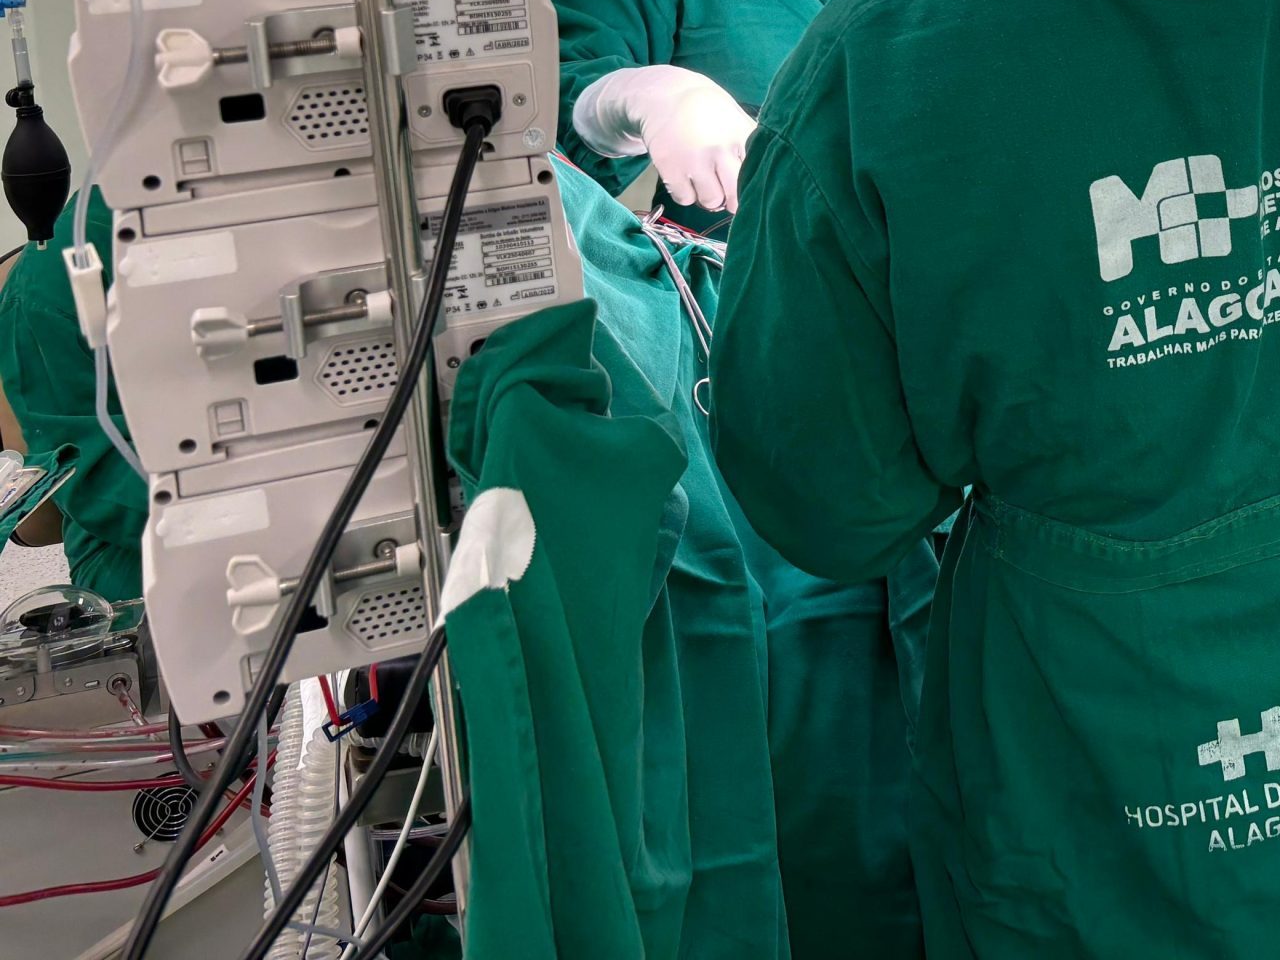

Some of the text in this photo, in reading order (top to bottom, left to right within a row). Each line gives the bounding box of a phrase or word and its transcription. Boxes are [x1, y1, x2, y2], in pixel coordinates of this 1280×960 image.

[1103, 282, 1210, 316] GOVERNO
[1221, 276, 1248, 291] DO
[1107, 342, 1192, 369] TRABALHAR
[1196, 331, 1227, 352] MAIS
[1124, 789, 1260, 828] HOSPITAL
